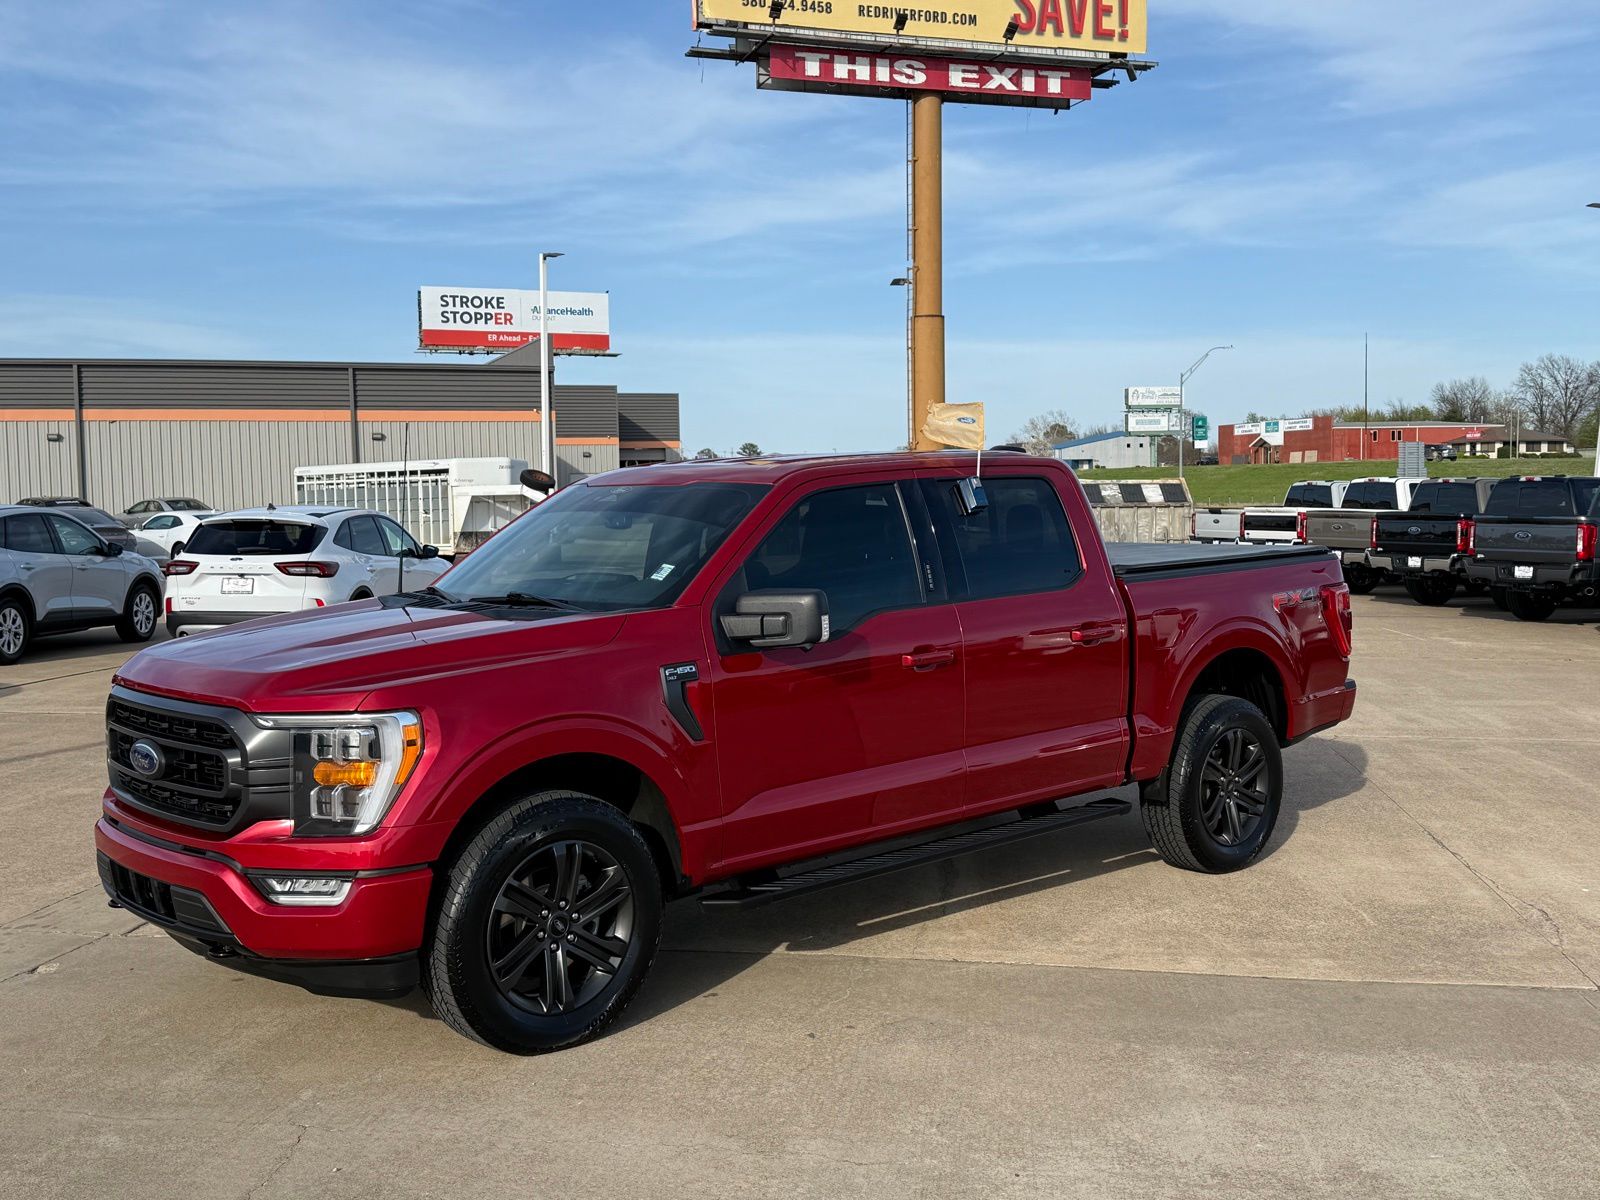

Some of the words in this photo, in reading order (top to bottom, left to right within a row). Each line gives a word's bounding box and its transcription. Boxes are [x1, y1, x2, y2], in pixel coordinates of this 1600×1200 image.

[857, 4, 978, 27] REDRIVERFORD.COM
[1010, 0, 1129, 42] SAVE!
[795, 51, 927, 85] THIS
[948, 63, 1071, 94] EXIT
[440, 294, 506, 310] STROKE
[440, 310, 514, 326] STOPPER
[532, 305, 594, 317] AlanceHealth
[488, 334, 498, 342] ER
[499, 334, 521, 342] Ahead
[1272, 586, 1318, 613] FX4
[665, 665, 696, 676] F-150
